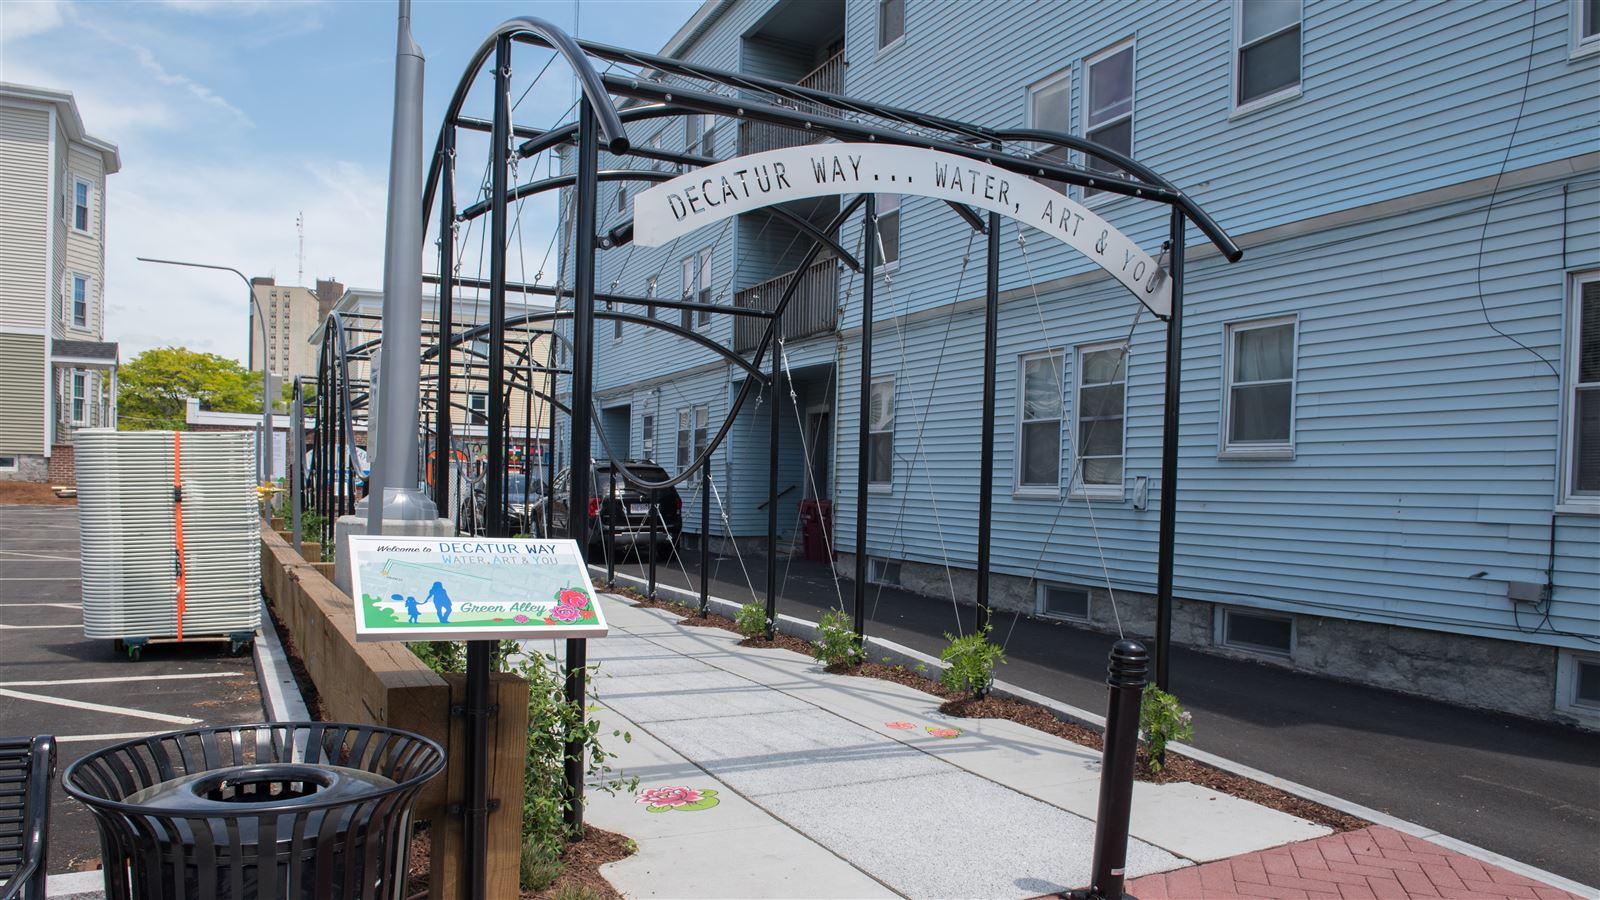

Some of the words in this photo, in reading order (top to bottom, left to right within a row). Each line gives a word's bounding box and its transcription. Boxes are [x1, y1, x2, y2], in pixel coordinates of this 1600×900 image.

[666, 162, 791, 222] DECATUR
[935, 161, 1020, 214] WATER,
[1041, 200, 1085, 237] ART
[1095, 229, 1108, 256] &
[1122, 248, 1161, 294] YOU
[376, 545, 421, 553] Welcome
[422, 545, 432, 553] to
[439, 542, 520, 554] DECATUR
[525, 544, 556, 554] WAY
[441, 554, 491, 565] WATER,
[493, 554, 516, 565] ART
[521, 555, 529, 565] &
[531, 555, 559, 566] YOU
[460, 602, 506, 613] Green
[509, 602, 548, 617] Alley
